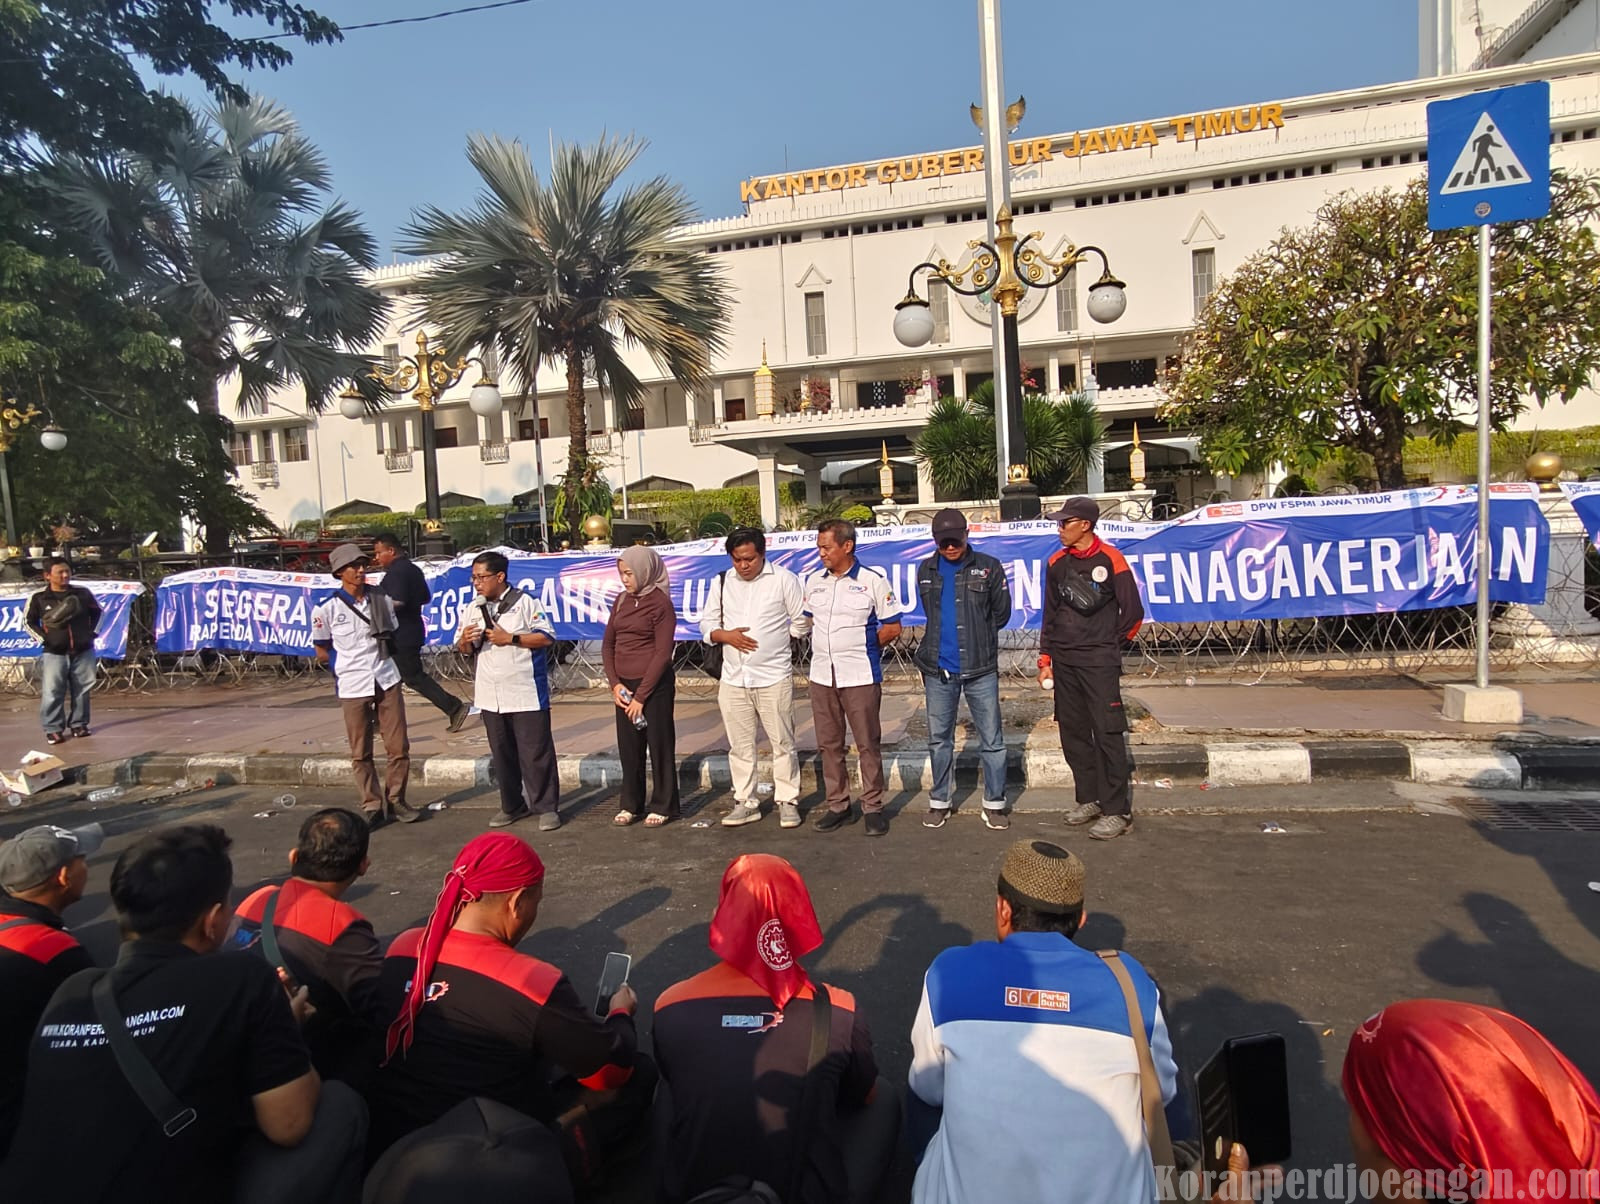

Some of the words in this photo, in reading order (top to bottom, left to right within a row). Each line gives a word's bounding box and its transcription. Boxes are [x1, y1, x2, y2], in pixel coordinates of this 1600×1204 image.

[740, 166, 867, 202] KANTOR
[877, 138, 1052, 184] GUBERUR
[1063, 121, 1159, 158] JAWA
[1169, 104, 1286, 143] TIMUR
[1251, 501, 1277, 512] DPW
[1281, 500, 1316, 509] FSPMI
[1320, 498, 1352, 507] JAWA
[1354, 494, 1392, 505] TIMUR
[1008, 523, 1033, 531] DPW
[1102, 523, 1135, 533] TIMUR
[862, 528, 892, 538] TIMUR
[778, 534, 799, 544] DPW
[205, 588, 308, 627] SEGERA
[1008, 990, 1018, 1004] 6
[1041, 992, 1068, 1002] Partai
[50, 1039, 77, 1049] SUARA
[83, 1037, 109, 1048] KAU
